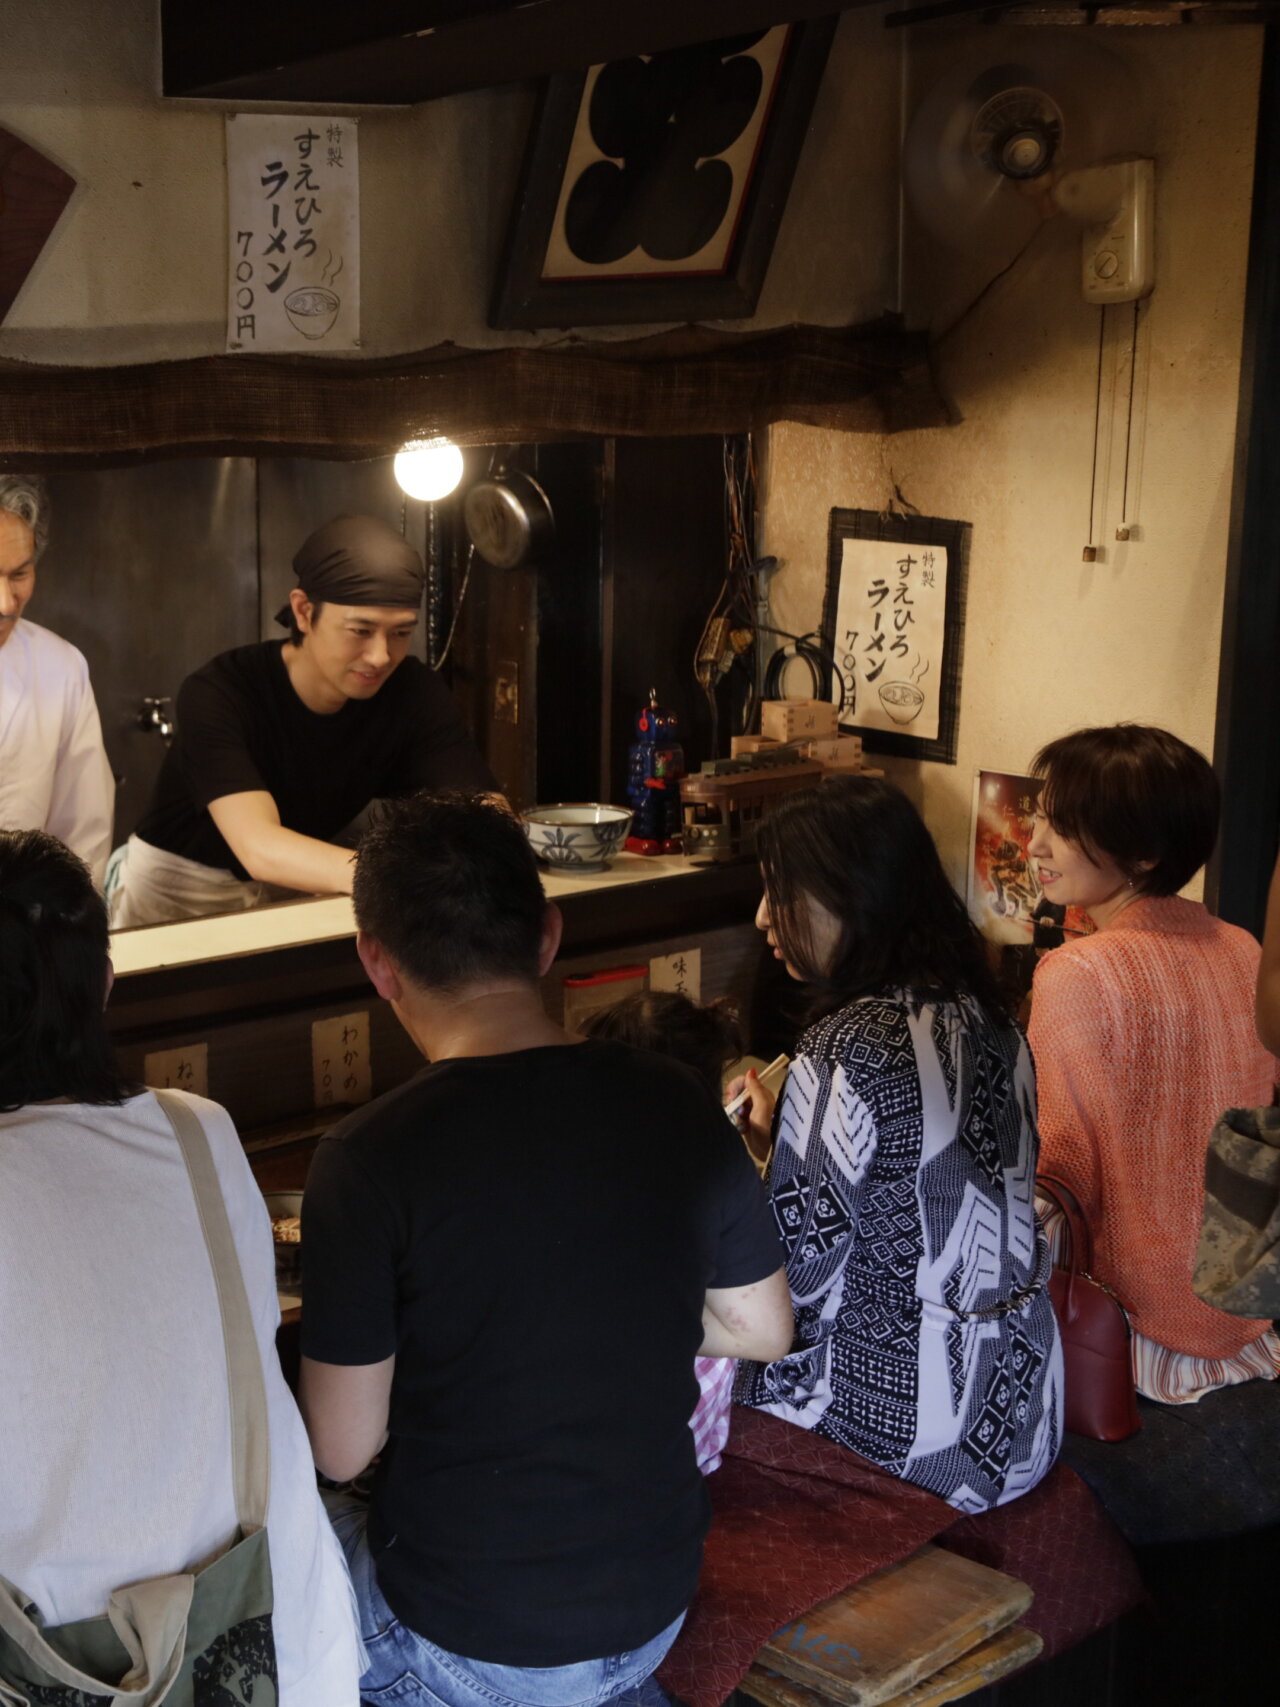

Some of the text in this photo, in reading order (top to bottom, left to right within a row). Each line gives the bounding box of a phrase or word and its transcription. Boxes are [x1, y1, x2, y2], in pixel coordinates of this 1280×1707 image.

[326, 124, 344, 168] 特製
[261, 161, 291, 294] ラーメン
[293, 128, 322, 258] すえひろ
[890, 554, 918, 658] すえひろ
[922, 552, 936, 589] 特製
[864, 579, 890, 682] ラーメン
[176, 1056, 194, 1091] ね
[342, 1025, 359, 1090] わかめ
